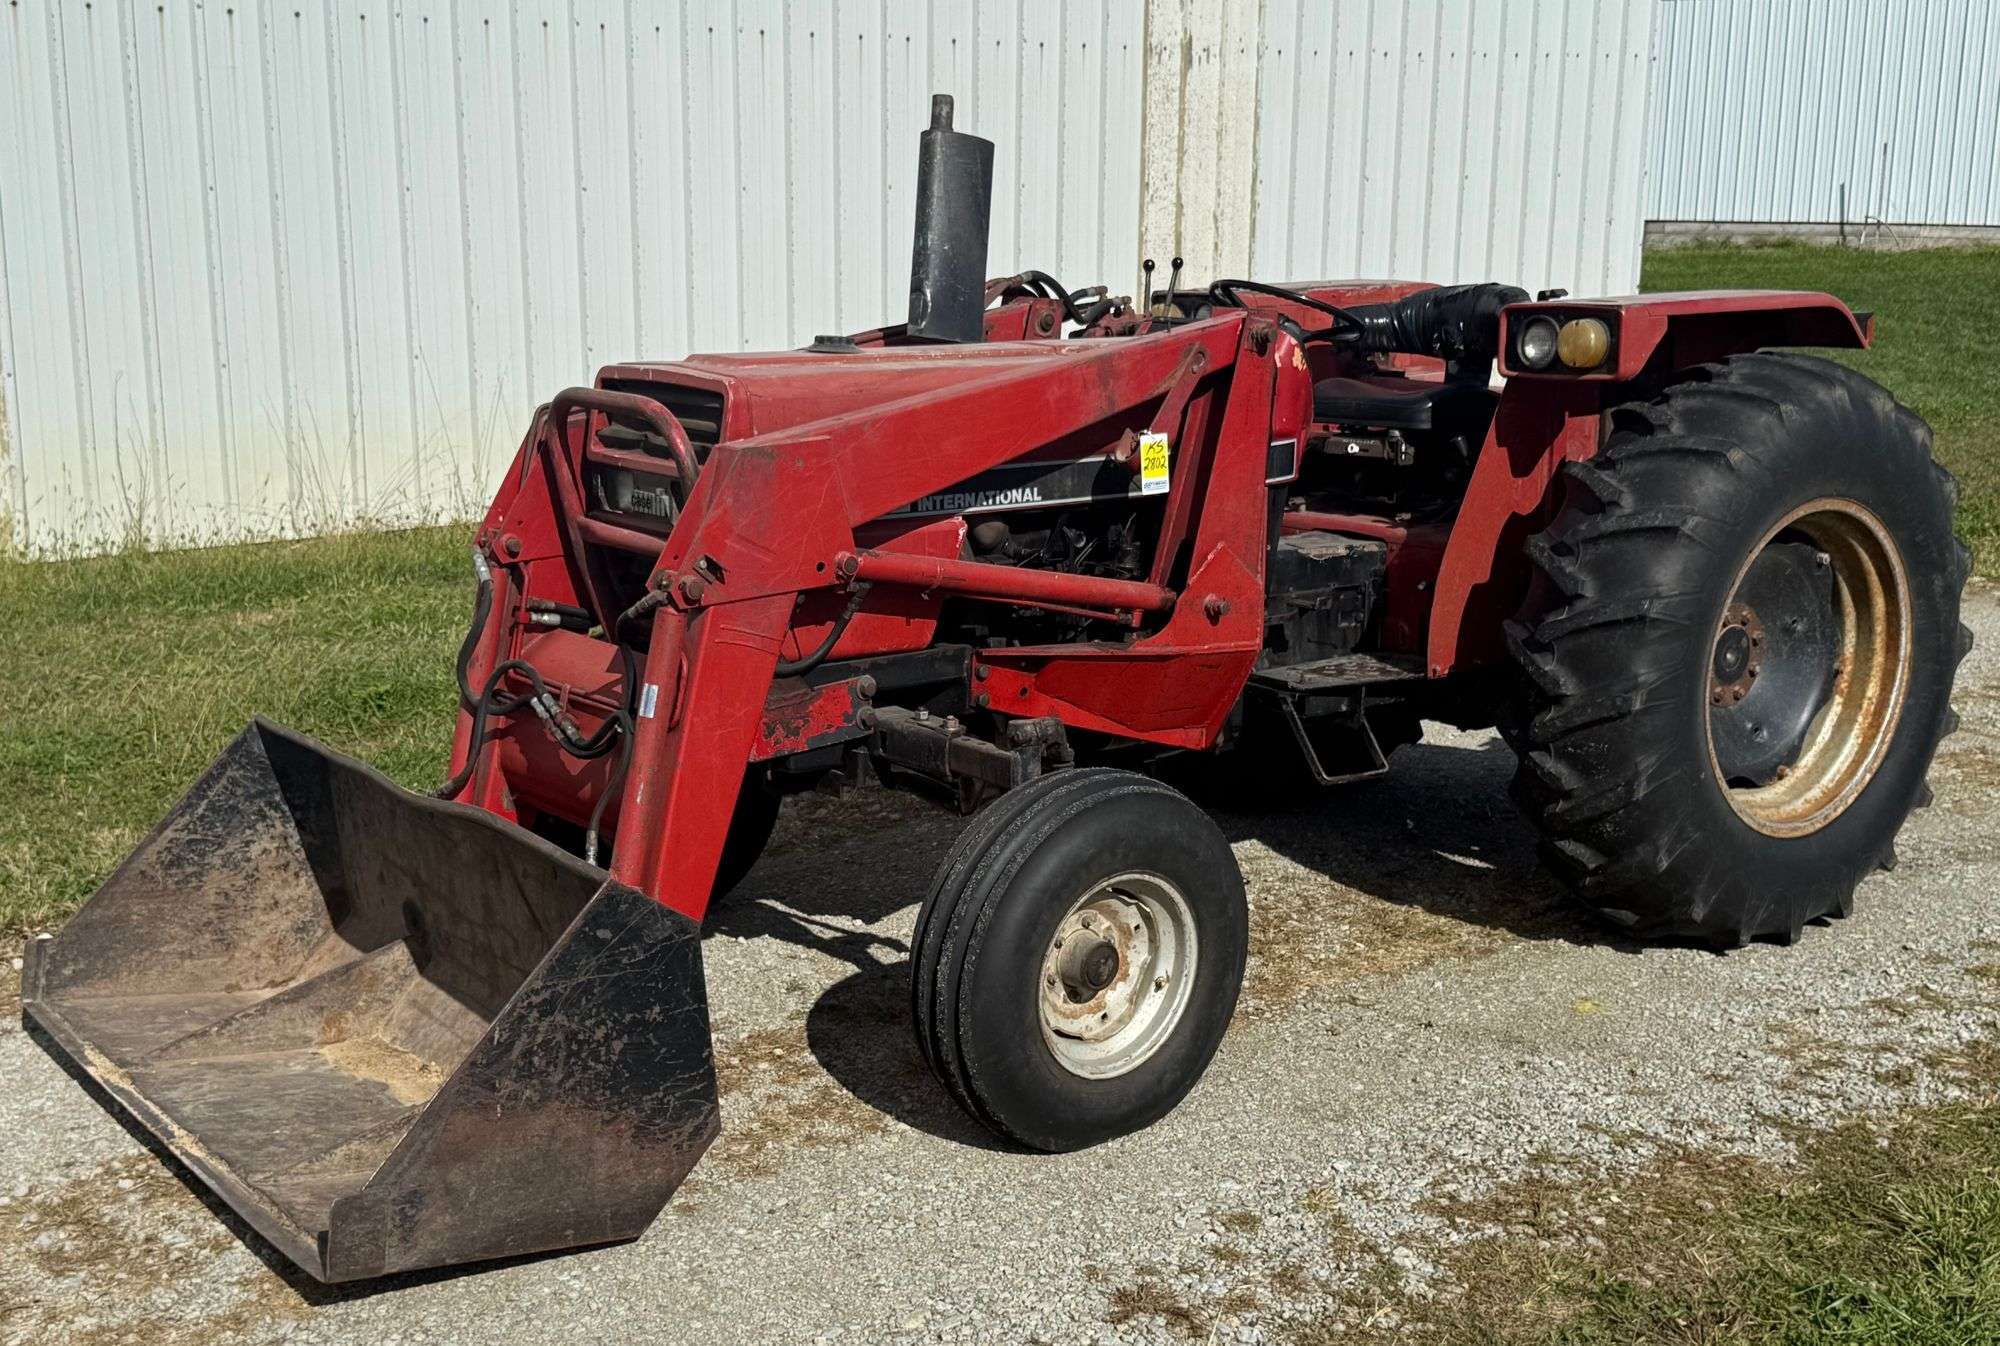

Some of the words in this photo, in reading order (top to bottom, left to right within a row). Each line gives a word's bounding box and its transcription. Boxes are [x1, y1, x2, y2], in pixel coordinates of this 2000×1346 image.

[1146, 439, 1164, 455] KS
[1143, 455, 1167, 471] 2802
[917, 487, 1042, 512] INTERNATIONAL
